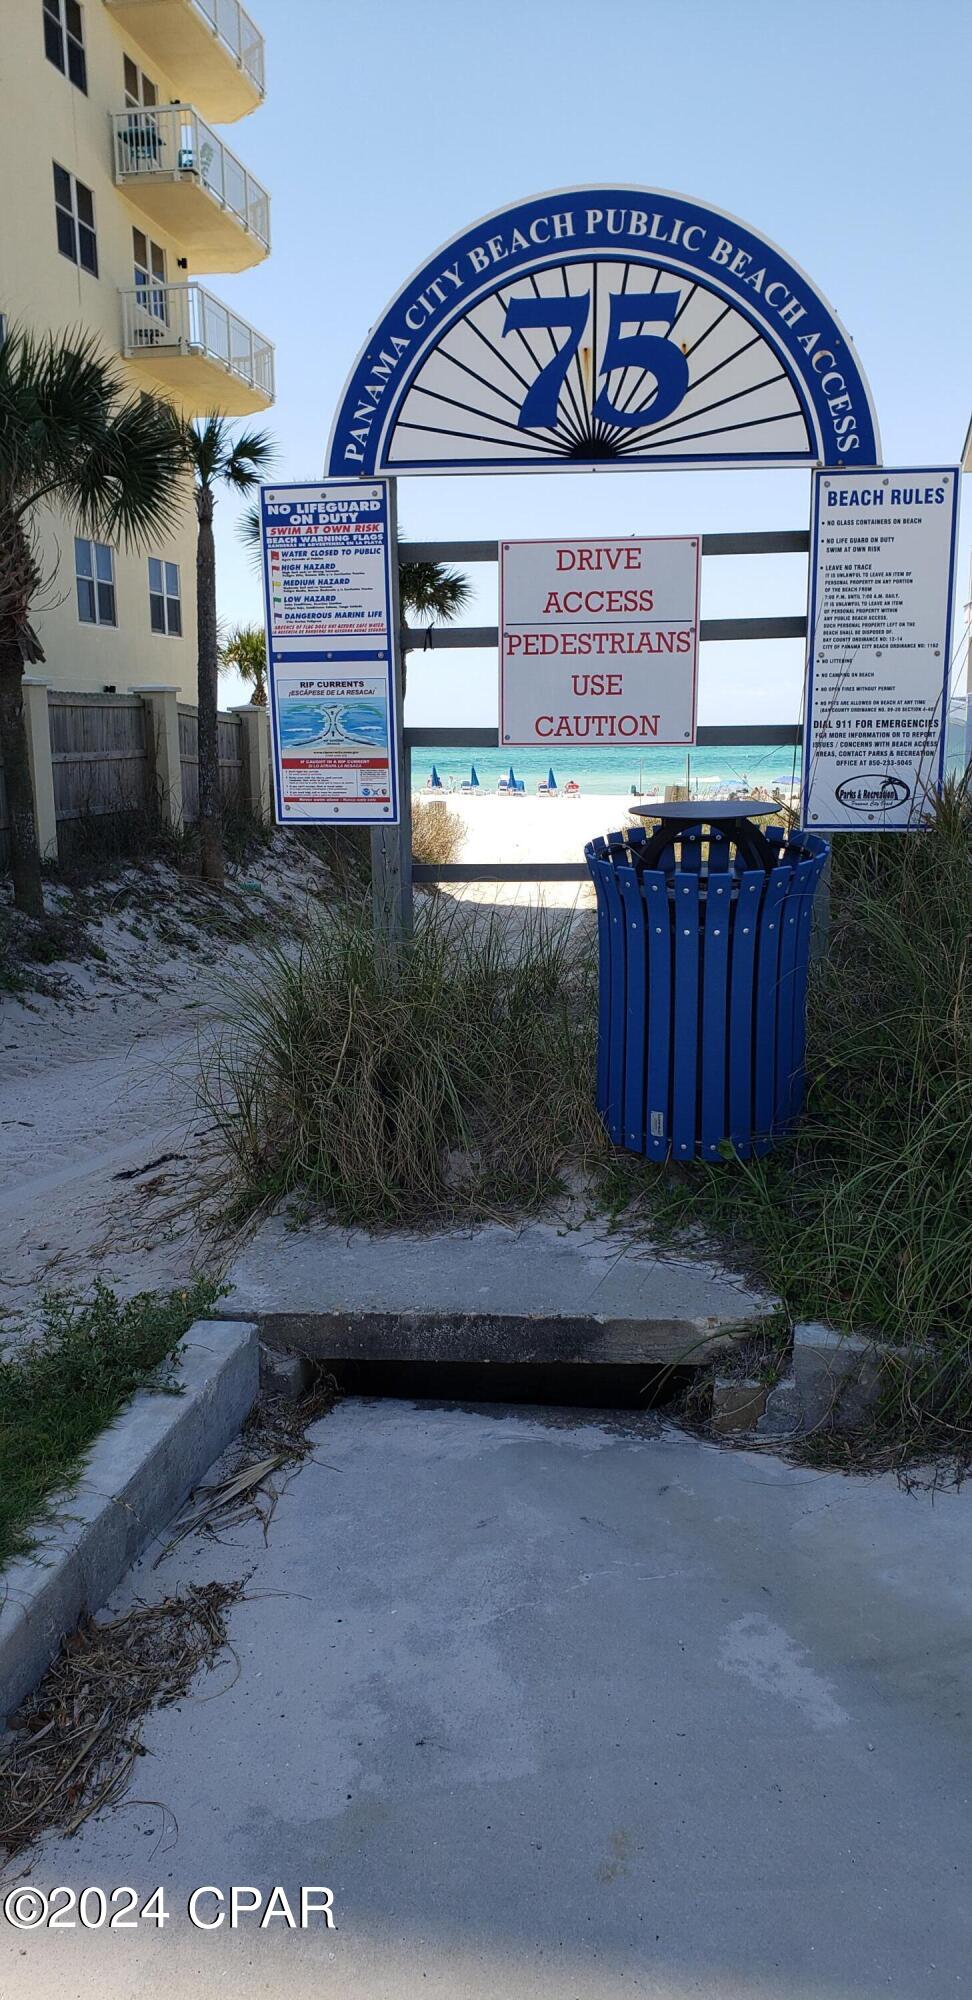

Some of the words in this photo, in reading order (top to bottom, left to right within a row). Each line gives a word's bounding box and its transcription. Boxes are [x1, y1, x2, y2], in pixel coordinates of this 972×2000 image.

[344, 334, 411, 462] PANAMA
[405, 263, 466, 331] CITY
[467, 212, 575, 273] BEACH
[586, 209, 707, 251] PUBLIC
[709, 237, 807, 328] BEACH
[798, 332, 860, 453] ACCESS
[501, 289, 690, 428] 75
[828, 490, 883, 506] BEACH
[891, 488, 944, 505] RULES
[268, 504, 290, 515] NO
[296, 501, 380, 514] LIFEGUARD
[290, 514, 312, 525] ON
[319, 512, 358, 524] DUTY
[270, 527, 300, 535] SWIM
[306, 526, 318, 534] AT
[323, 525, 350, 533] OWN
[354, 524, 379, 532] RISK
[556, 548, 641, 570] DRIVE
[543, 590, 653, 613] ACCESS
[506, 631, 691, 655] PEDESTRIANS
[571, 674, 622, 696] USE
[535, 715, 660, 736] CAUTION
[836, 720, 850, 728] 911
[855, 720, 872, 728] FOR
[840, 789, 856, 800] Parks
[863, 789, 895, 800] Recreation
